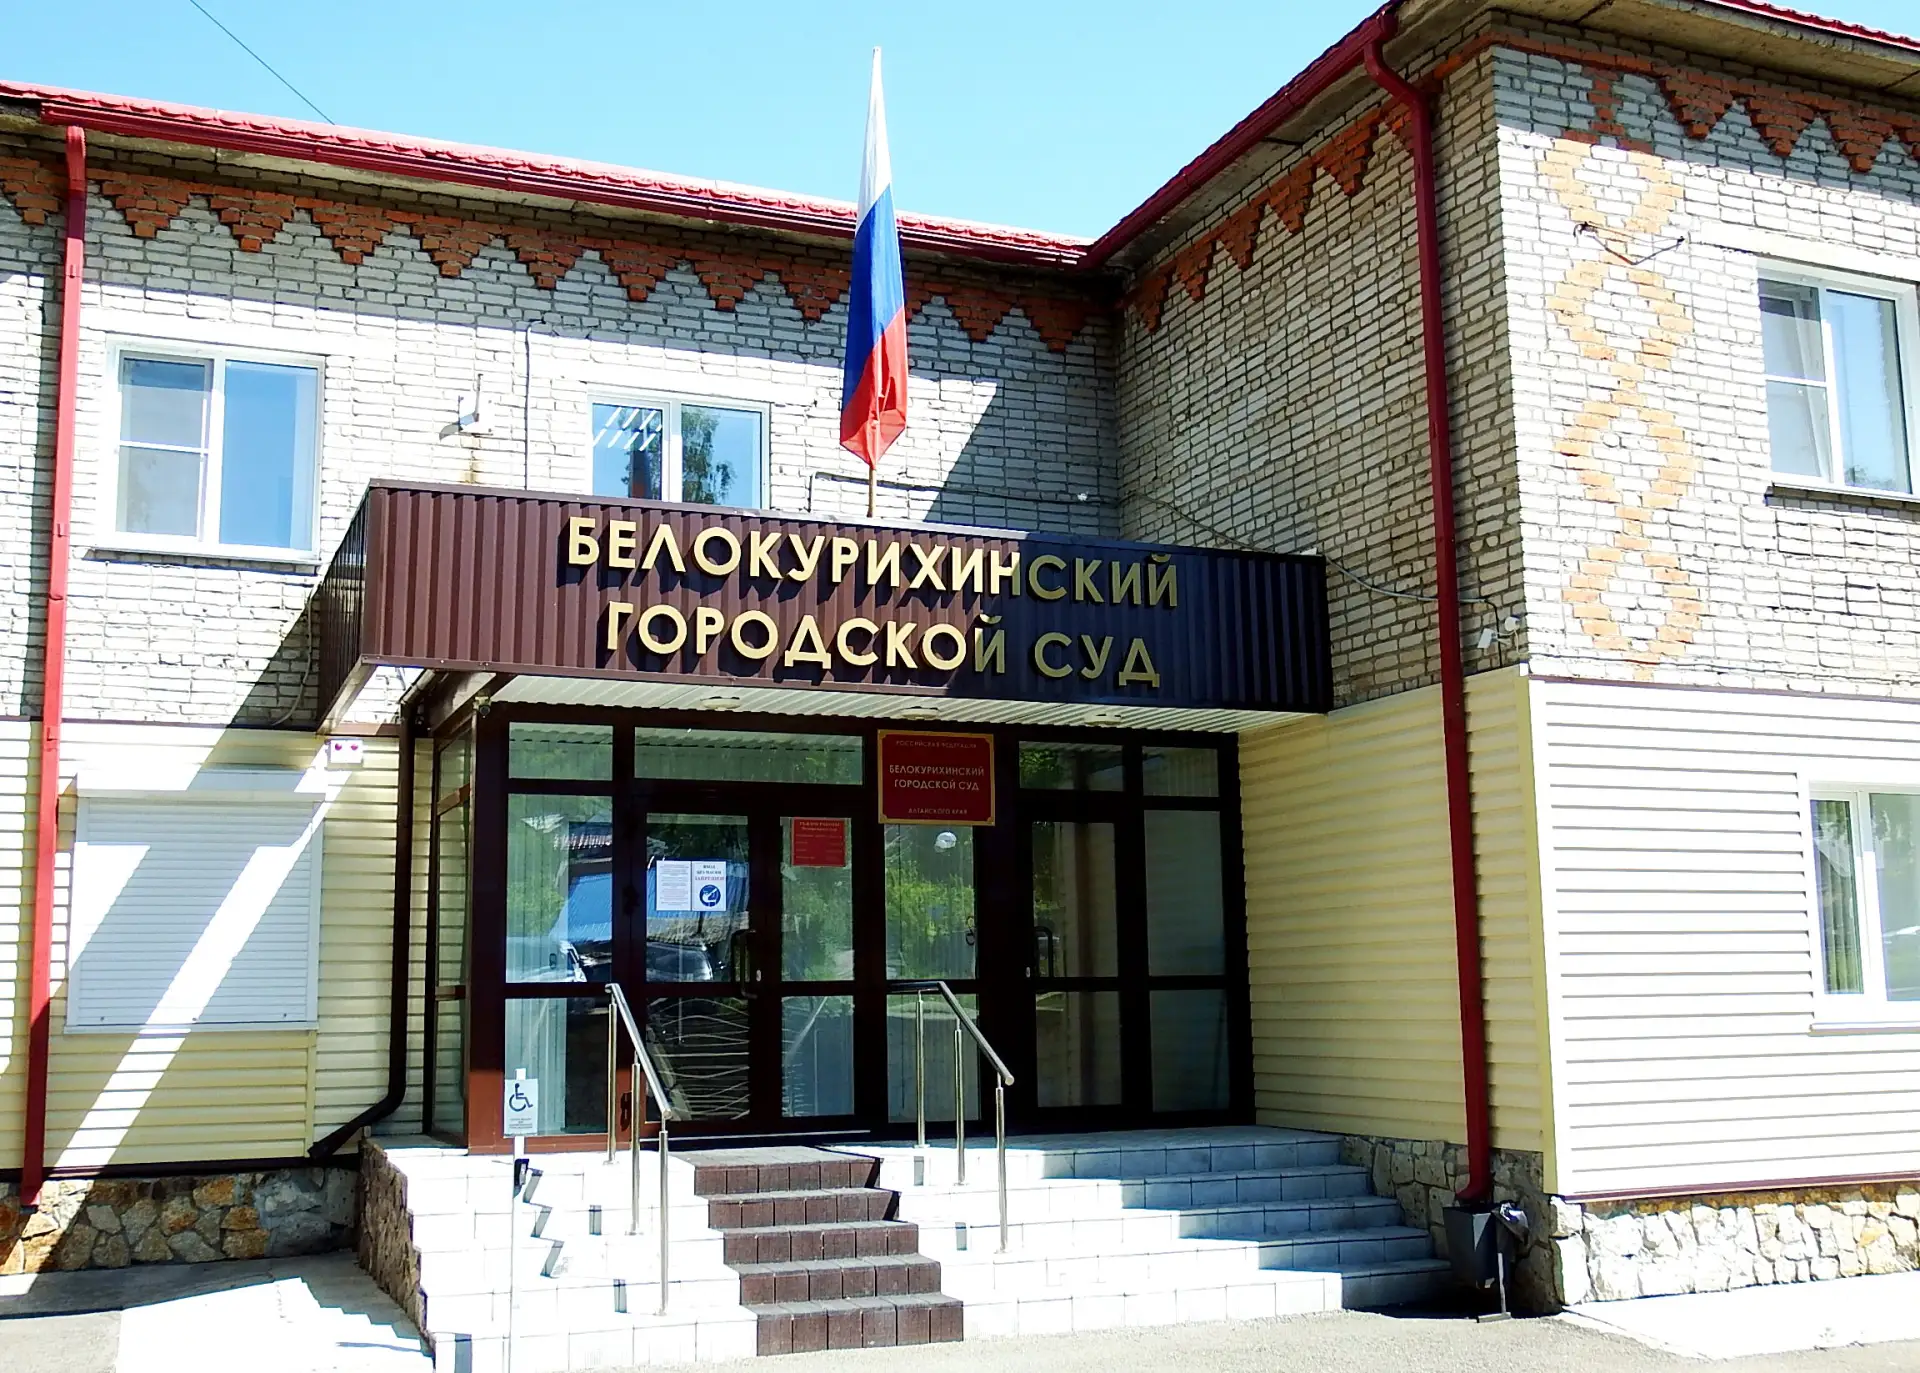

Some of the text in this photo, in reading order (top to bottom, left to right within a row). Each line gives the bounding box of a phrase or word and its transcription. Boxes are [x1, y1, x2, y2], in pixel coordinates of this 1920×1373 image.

[567, 516, 1178, 607] БЕЛОКУРИХИНСКИЙ
[607, 601, 1161, 688] ГОРОДСКОЙ СУД
[896, 740, 939, 748] РОССИЙСКАЯ
[889, 764, 985, 777] БЕЛОКУРИХИНСКИЙ
[894, 778, 980, 791] ГОРОДСКОЙ СУД
[908, 807, 951, 815] АЛТАЙСКОГО
